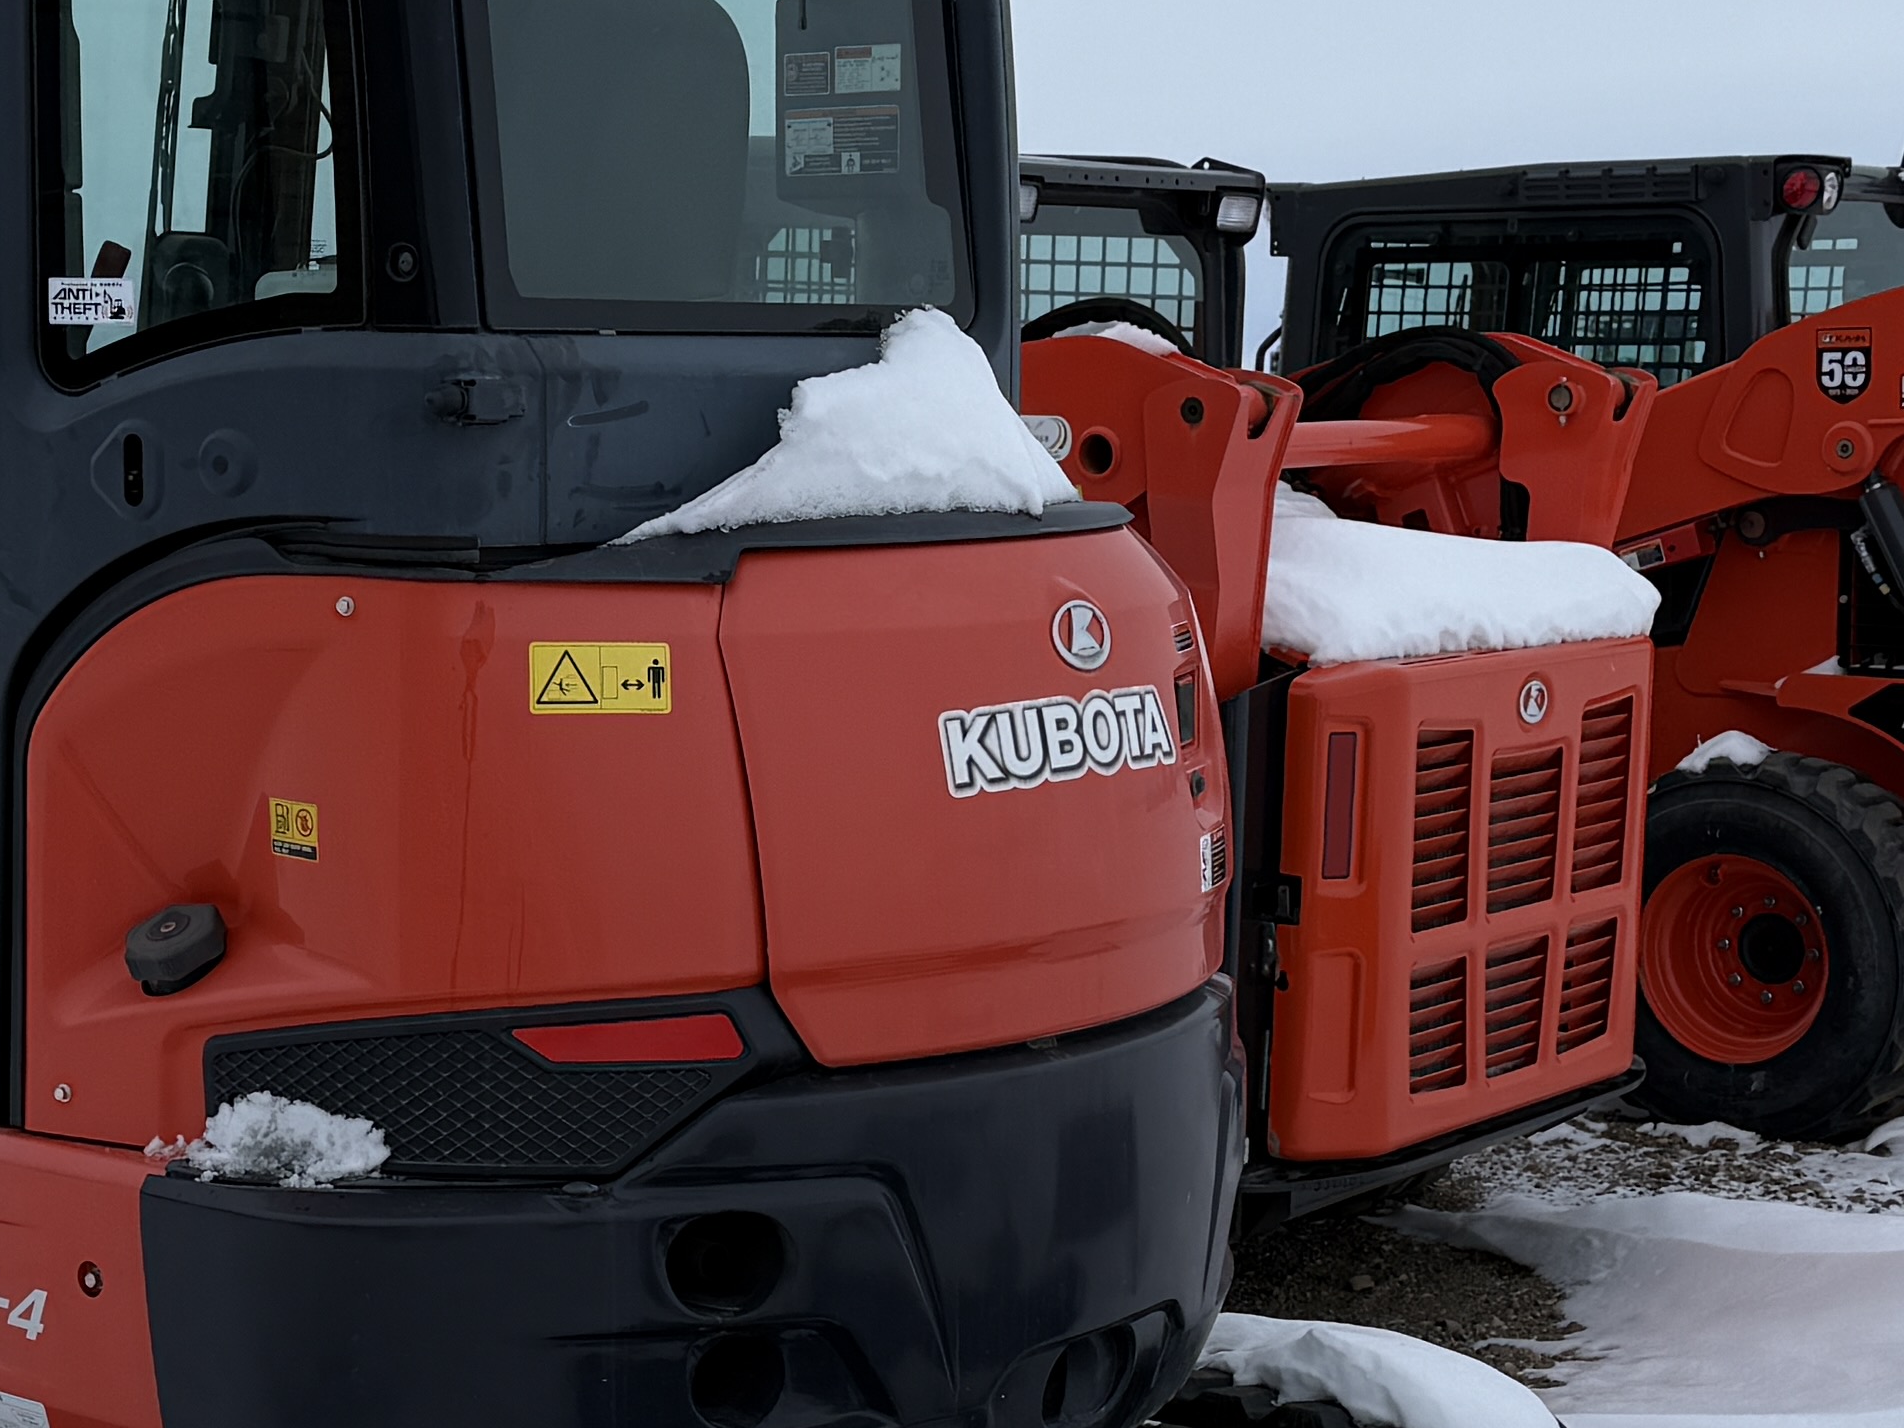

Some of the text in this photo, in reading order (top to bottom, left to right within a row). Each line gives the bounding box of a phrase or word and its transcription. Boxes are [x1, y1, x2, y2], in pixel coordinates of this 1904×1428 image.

[51, 302, 102, 315] THEFT
[1821, 350, 1866, 387] 50
[943, 691, 1173, 789] KUBOTA
